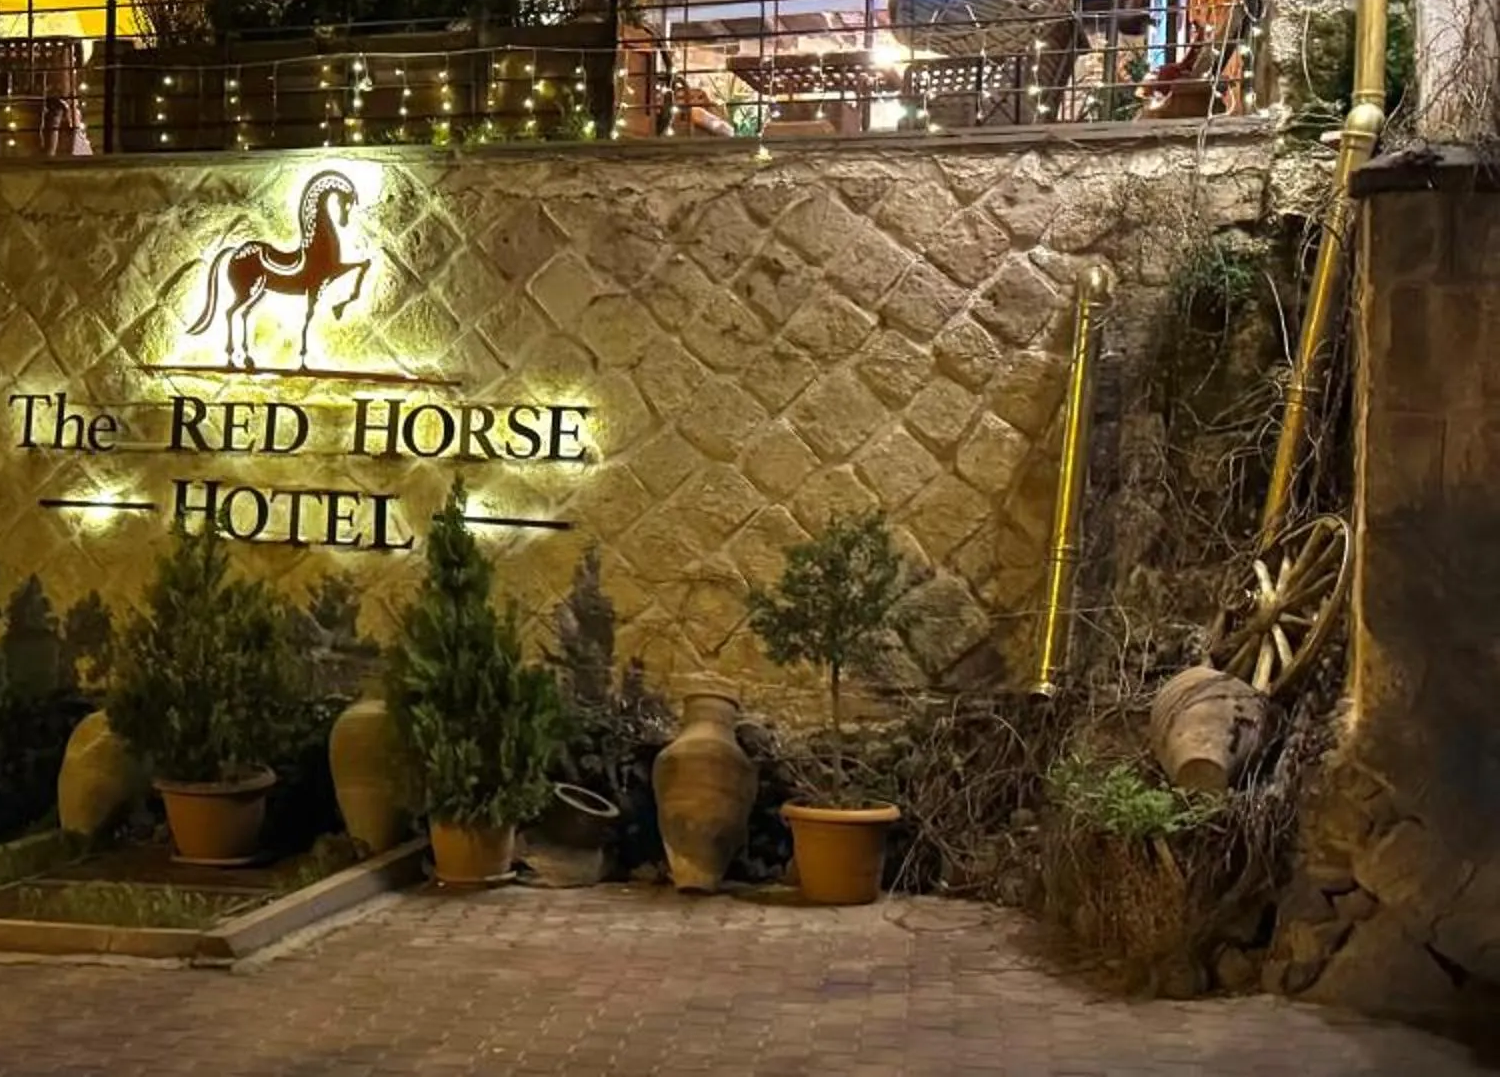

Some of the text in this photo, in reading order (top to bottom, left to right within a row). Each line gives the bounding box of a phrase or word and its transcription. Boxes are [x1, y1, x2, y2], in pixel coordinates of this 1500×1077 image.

[9, 391, 589, 463] The RED HORSE
[173, 478, 415, 552] HOTEL
